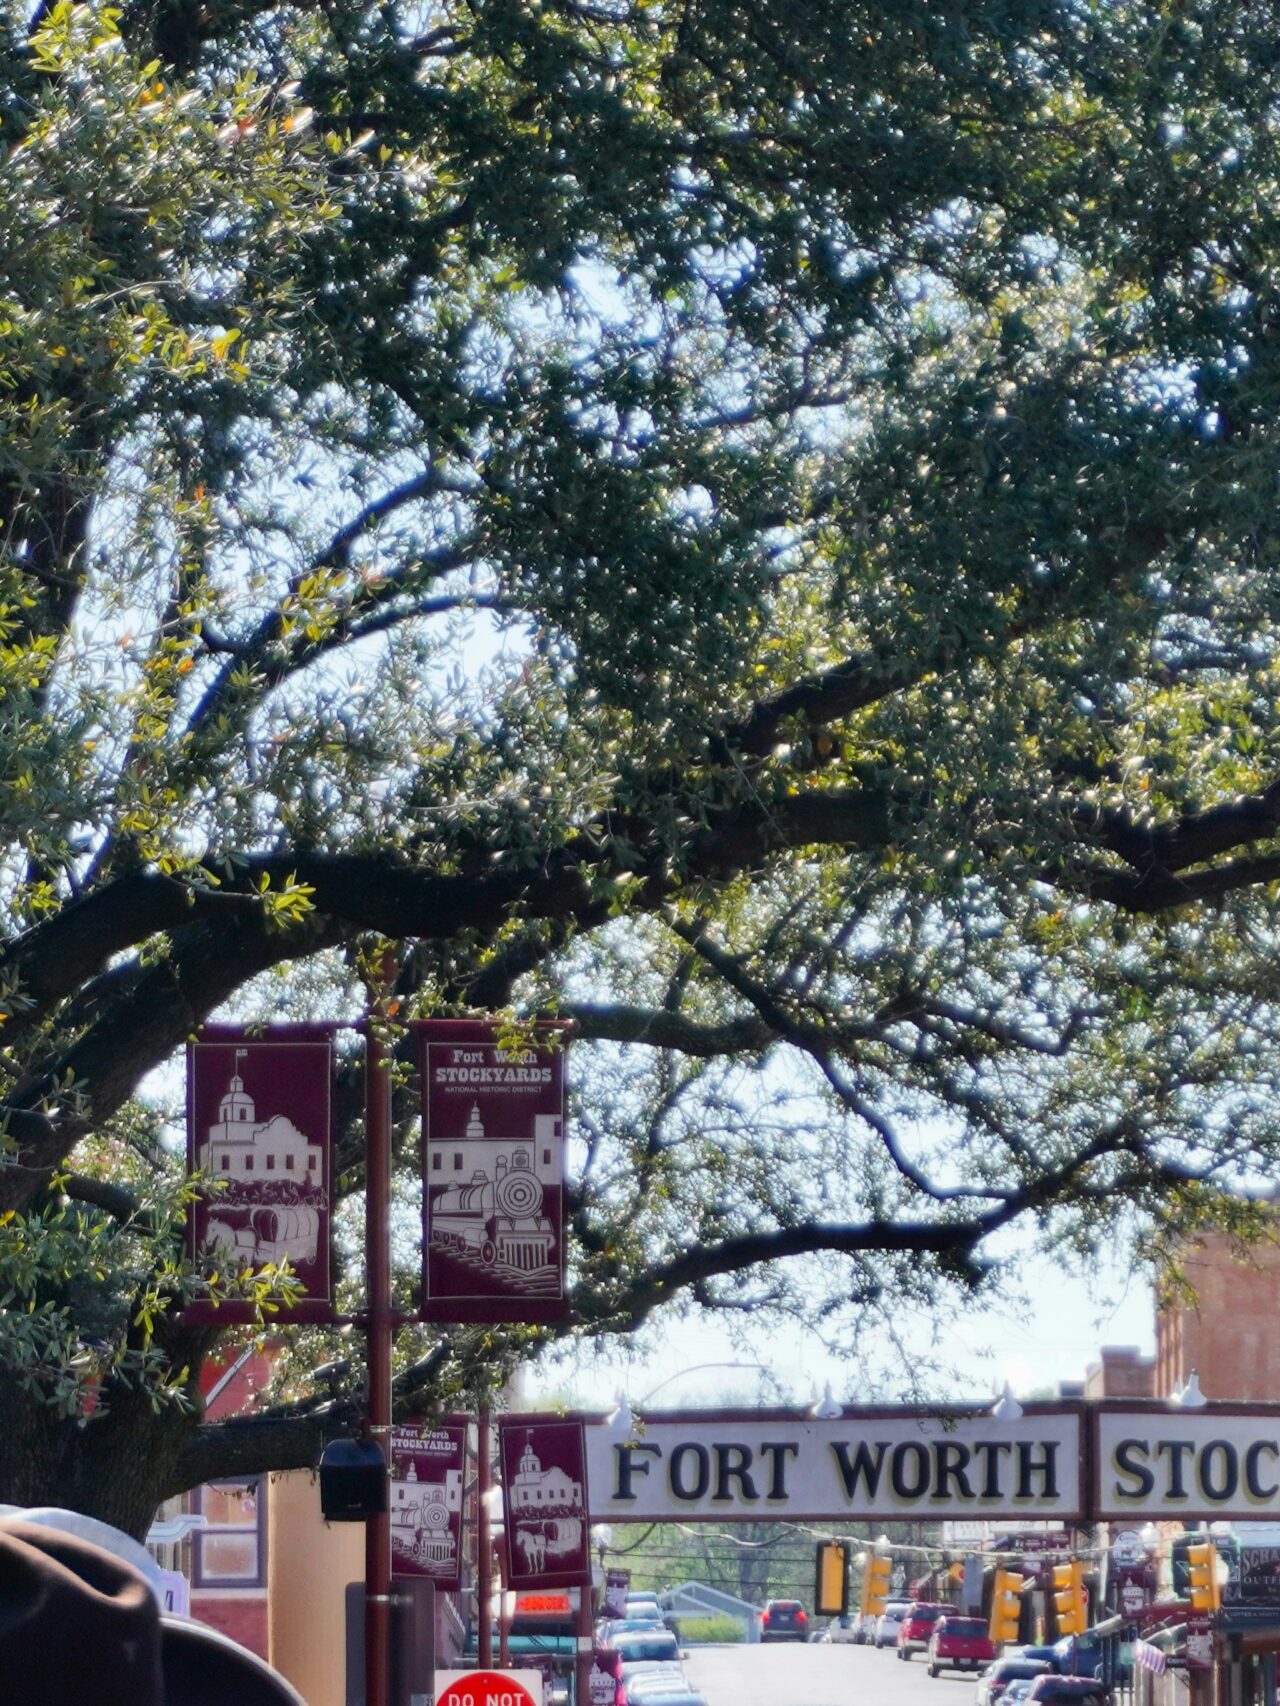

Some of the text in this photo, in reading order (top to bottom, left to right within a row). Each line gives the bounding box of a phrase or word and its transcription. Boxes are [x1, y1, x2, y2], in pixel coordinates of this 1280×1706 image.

[453, 1049, 538, 1063] Fort Wth
[436, 1067, 552, 1082] STOCKYARDS
[400, 1427, 419, 1437] Fort
[612, 1441, 799, 1501] FORT
[829, 1440, 1062, 1502] WORTH
[449, 1693, 475, 1706] DO
[486, 1693, 525, 1706] NOT
